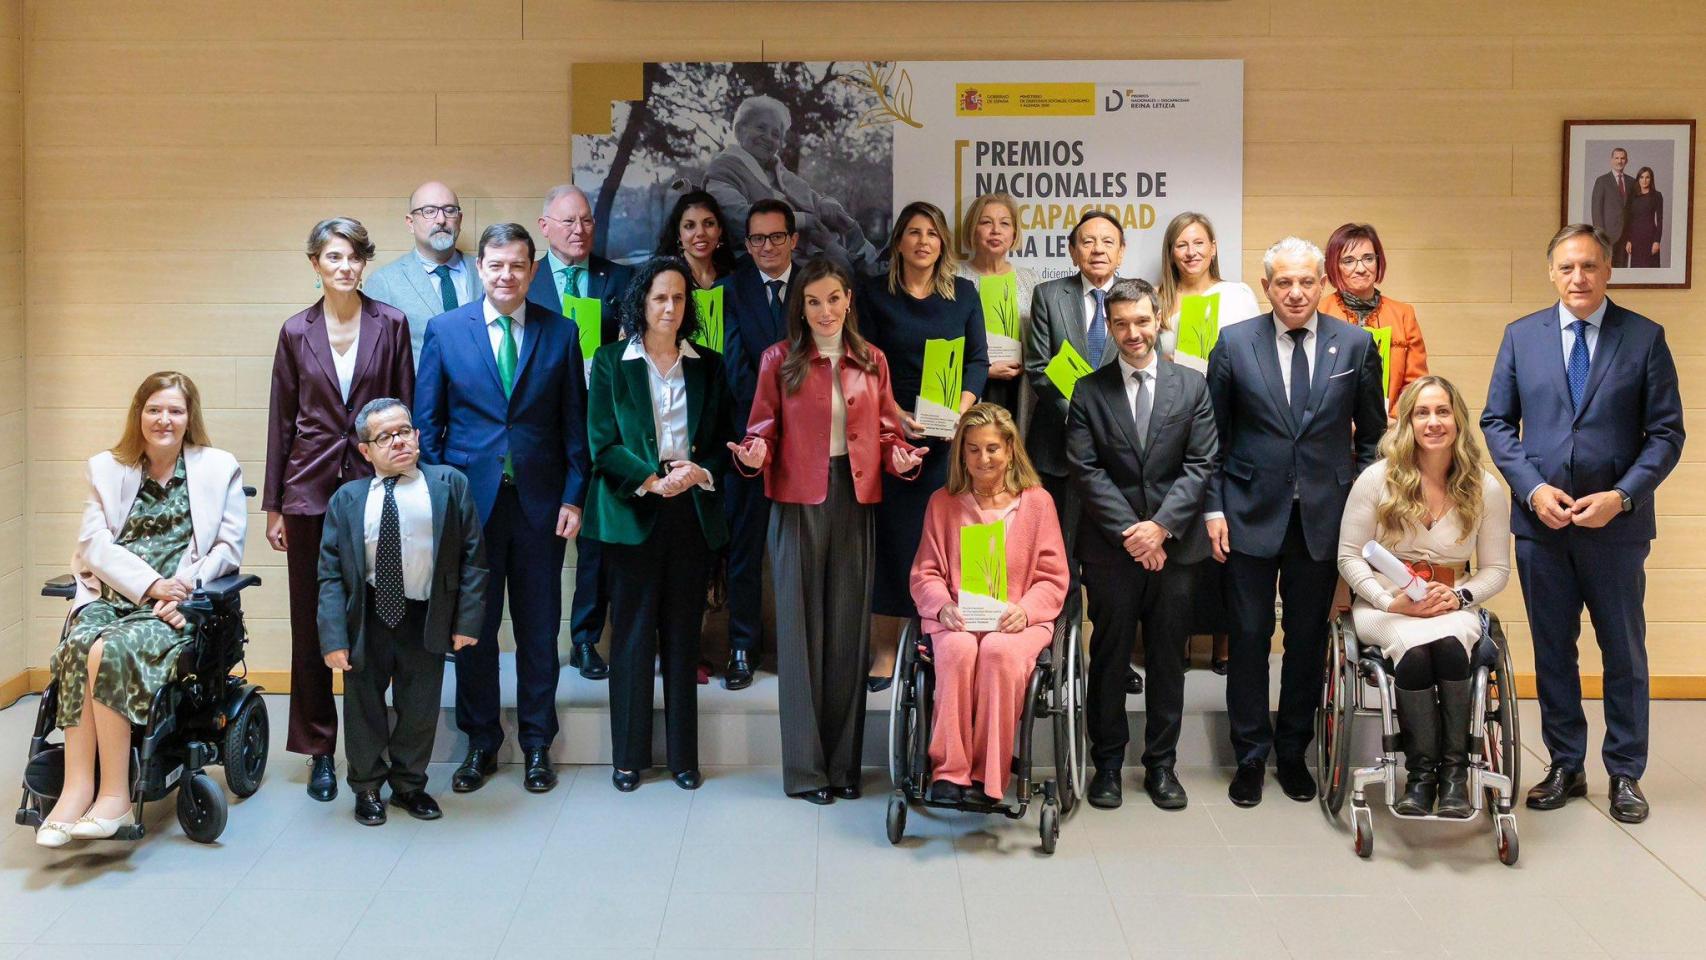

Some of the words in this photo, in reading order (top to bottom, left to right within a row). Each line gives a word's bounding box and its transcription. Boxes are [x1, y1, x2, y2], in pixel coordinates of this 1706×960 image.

[975, 140, 1084, 167] PREMIOS
[975, 172, 1127, 198] NACIONALES
[1136, 172, 1167, 197] DE
